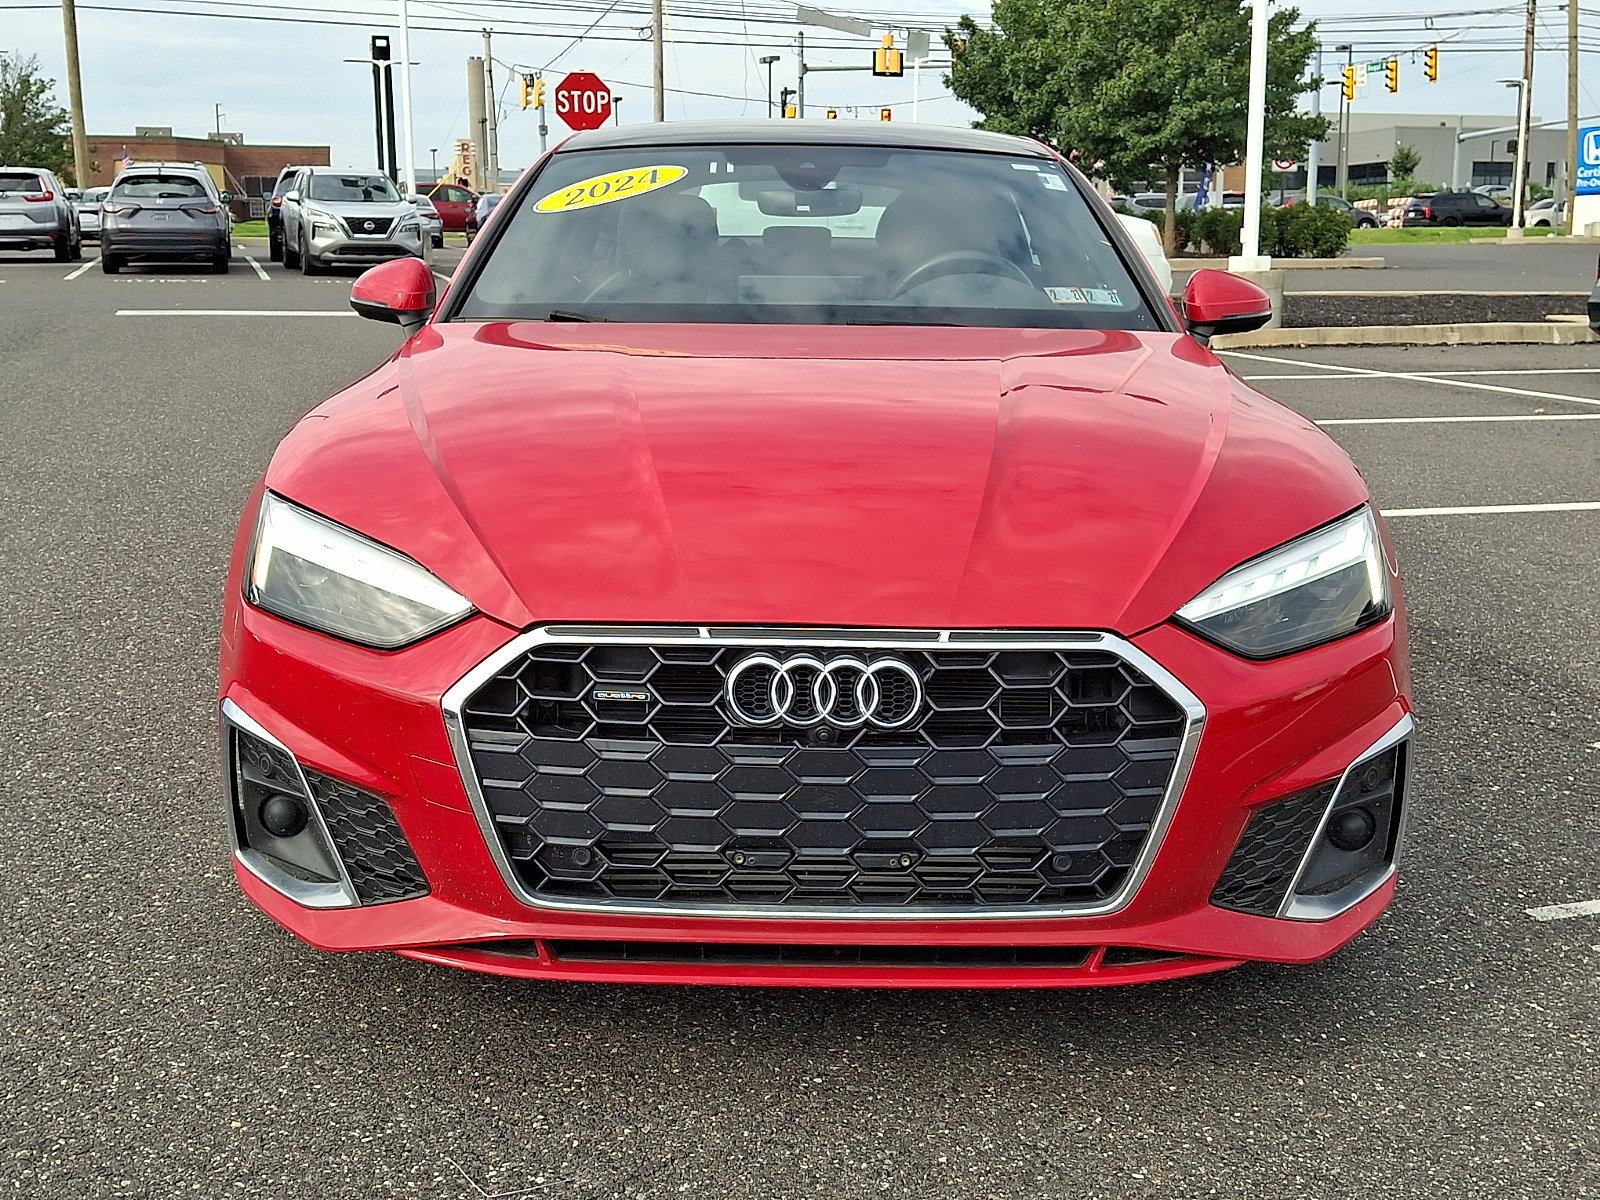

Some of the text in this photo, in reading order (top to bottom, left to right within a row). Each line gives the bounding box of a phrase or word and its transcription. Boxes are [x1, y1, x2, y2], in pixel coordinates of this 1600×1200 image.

[557, 90, 609, 114] STOP
[564, 169, 661, 207] 2024
[597, 692, 646, 700] quattro
